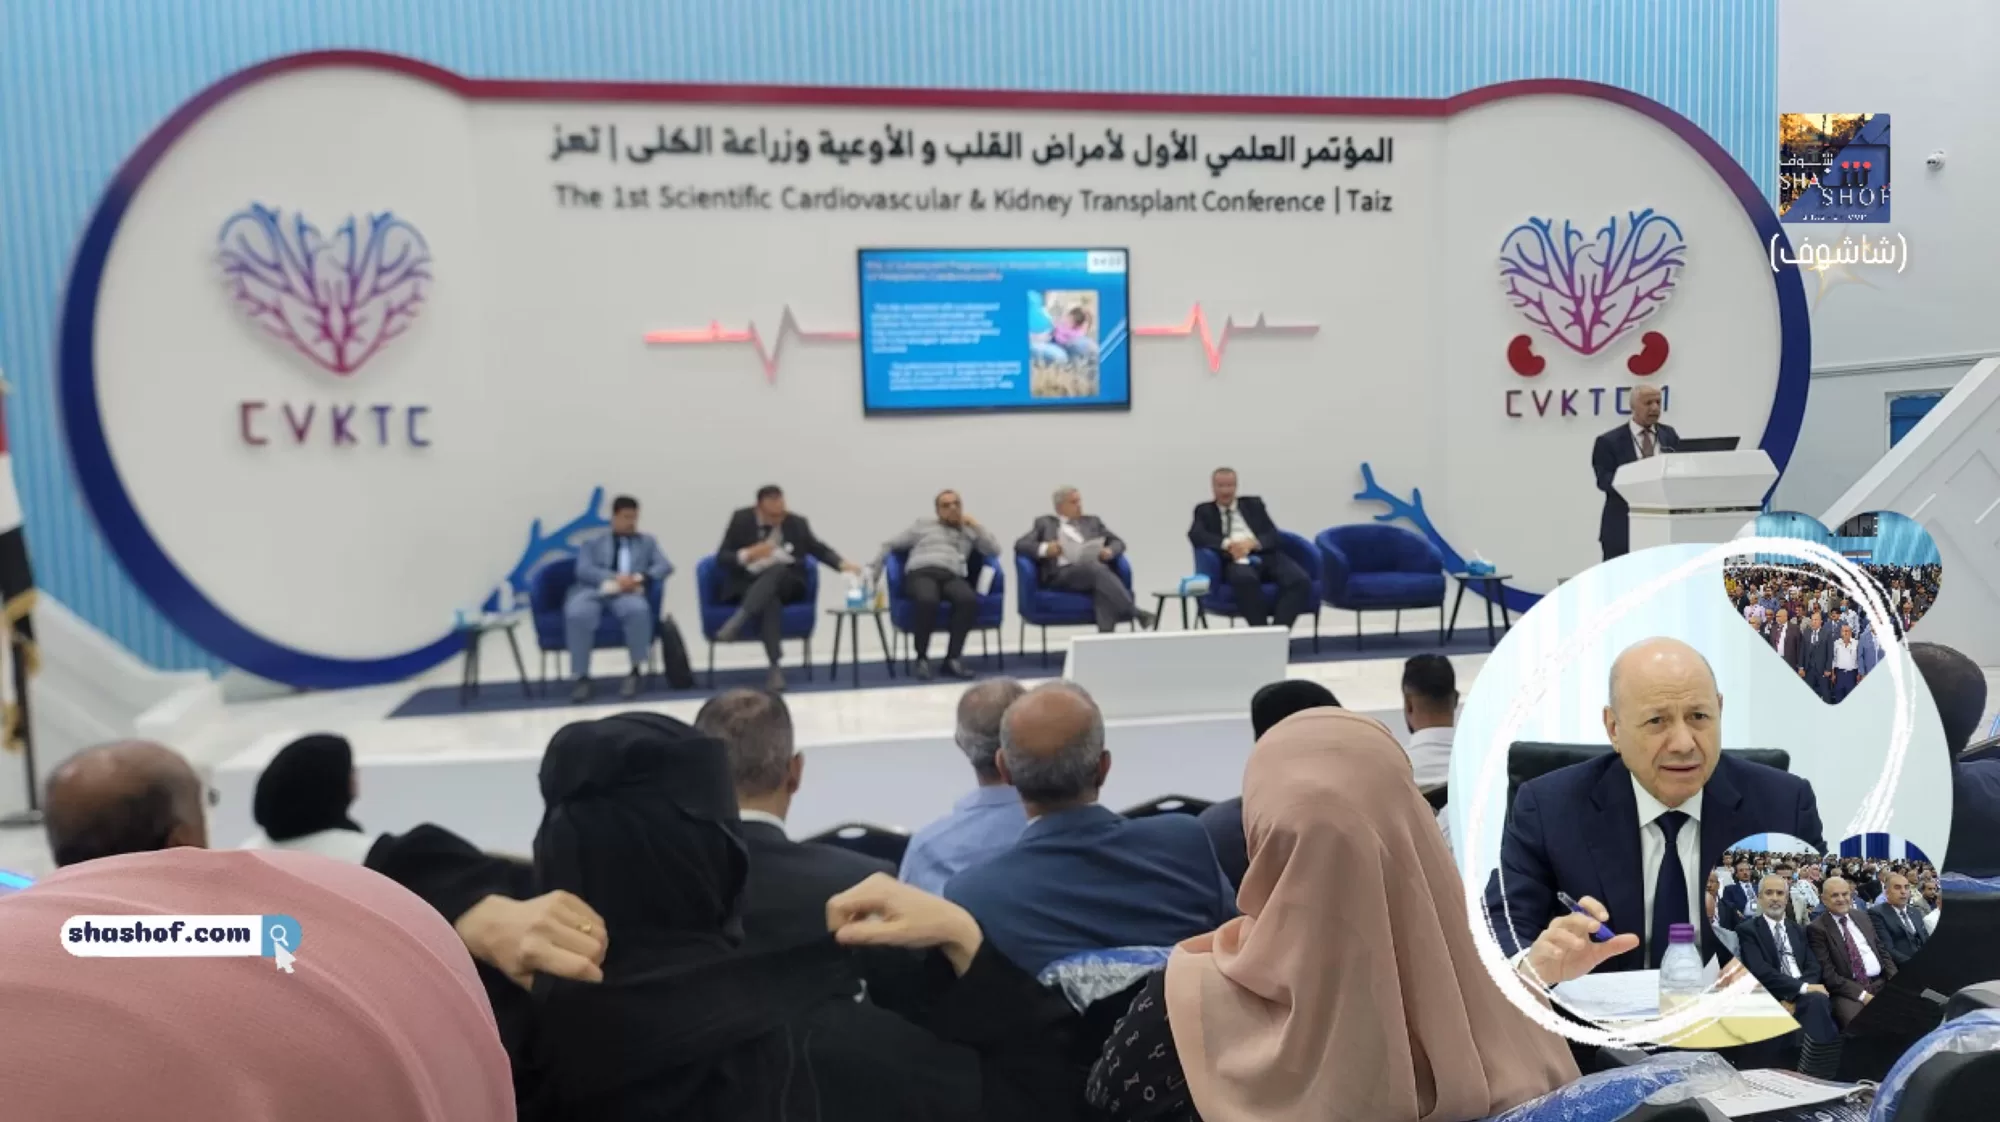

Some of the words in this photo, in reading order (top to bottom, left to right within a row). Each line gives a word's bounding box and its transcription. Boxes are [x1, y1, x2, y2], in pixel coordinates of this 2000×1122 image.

[550, 124, 601, 162] تعز
[626, 125, 713, 164] الكلى
[721, 126, 811, 164] وزراعة
[818, 123, 915, 166] الأوعية
[920, 139, 938, 167] و
[945, 130, 1023, 169] القلب
[1031, 128, 1126, 168] لأمراض
[1133, 129, 1198, 169] الأول
[1205, 134, 1296, 178] العلمي
[1301, 135, 1394, 170] المؤتمر
[555, 184, 602, 208] The
[615, 186, 649, 208] 1st
[659, 185, 770, 209] Scientific
[781, 186, 961, 211] Cardiovascular
[969, 188, 986, 211] &
[994, 189, 1073, 217] Kidney
[1079, 189, 1197, 217] Transplant
[1201, 188, 1326, 213] Conference
[1345, 188, 1393, 213] Taiz
[240, 401, 432, 448] CVKTC
